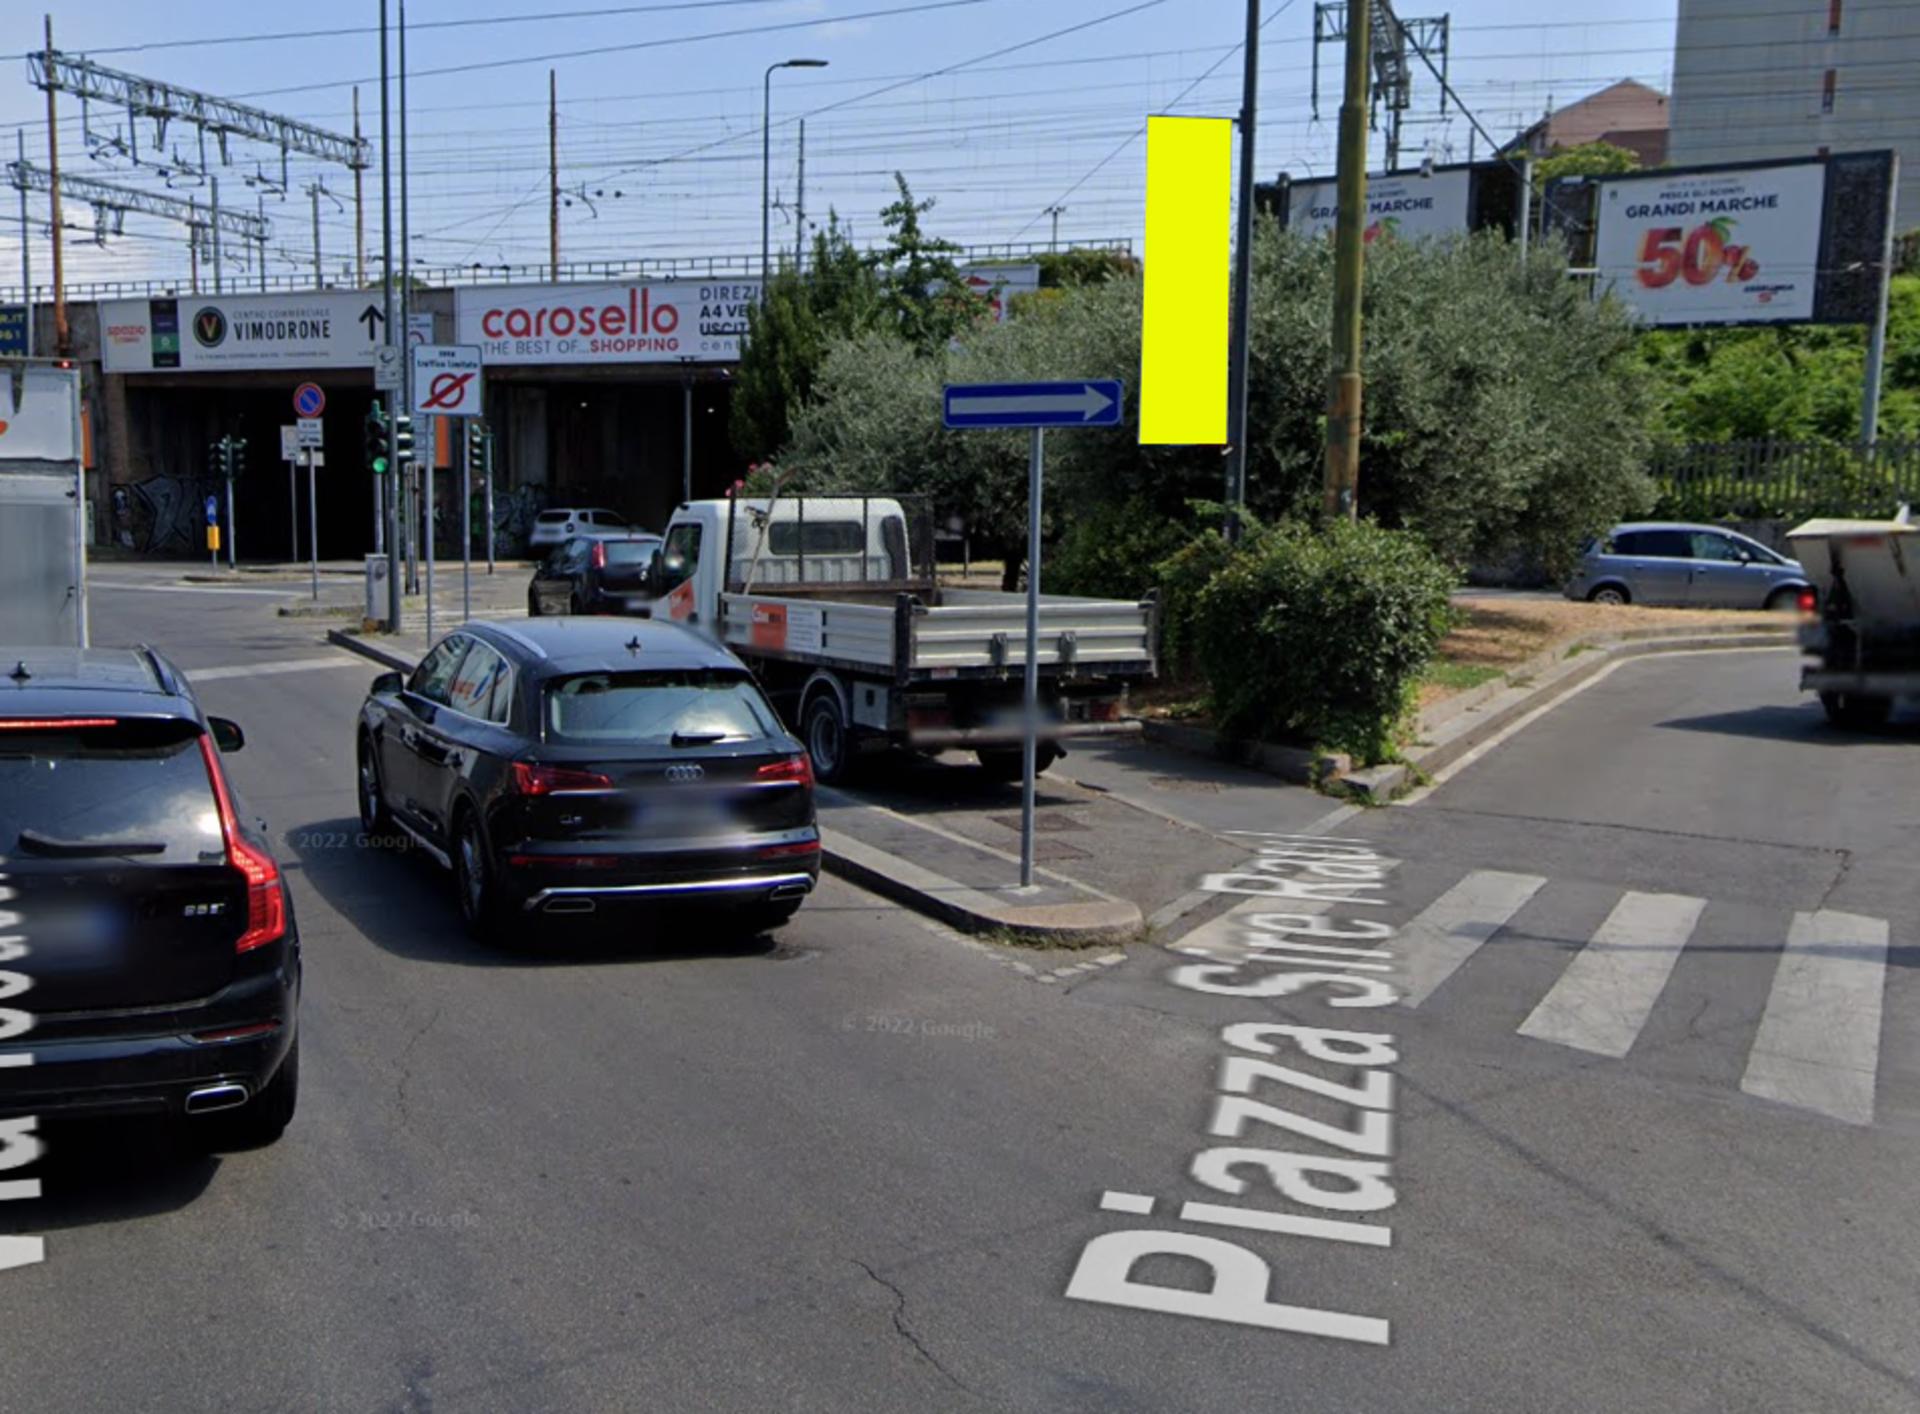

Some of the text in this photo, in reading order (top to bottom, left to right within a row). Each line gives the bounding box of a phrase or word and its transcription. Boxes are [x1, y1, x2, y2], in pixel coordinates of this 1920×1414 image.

[1370, 196, 1434, 213] MARCHE
[1625, 194, 1779, 219] GRANDI MARCHE
[1637, 224, 1759, 288] 50%
[233, 308, 331, 320] CENTRO COMMERCIALE
[482, 287, 679, 339] carosello
[700, 304, 722, 318] A4
[233, 319, 331, 341] VIMODRONE
[483, 340, 511, 356] THE
[516, 339, 551, 355] BEST
